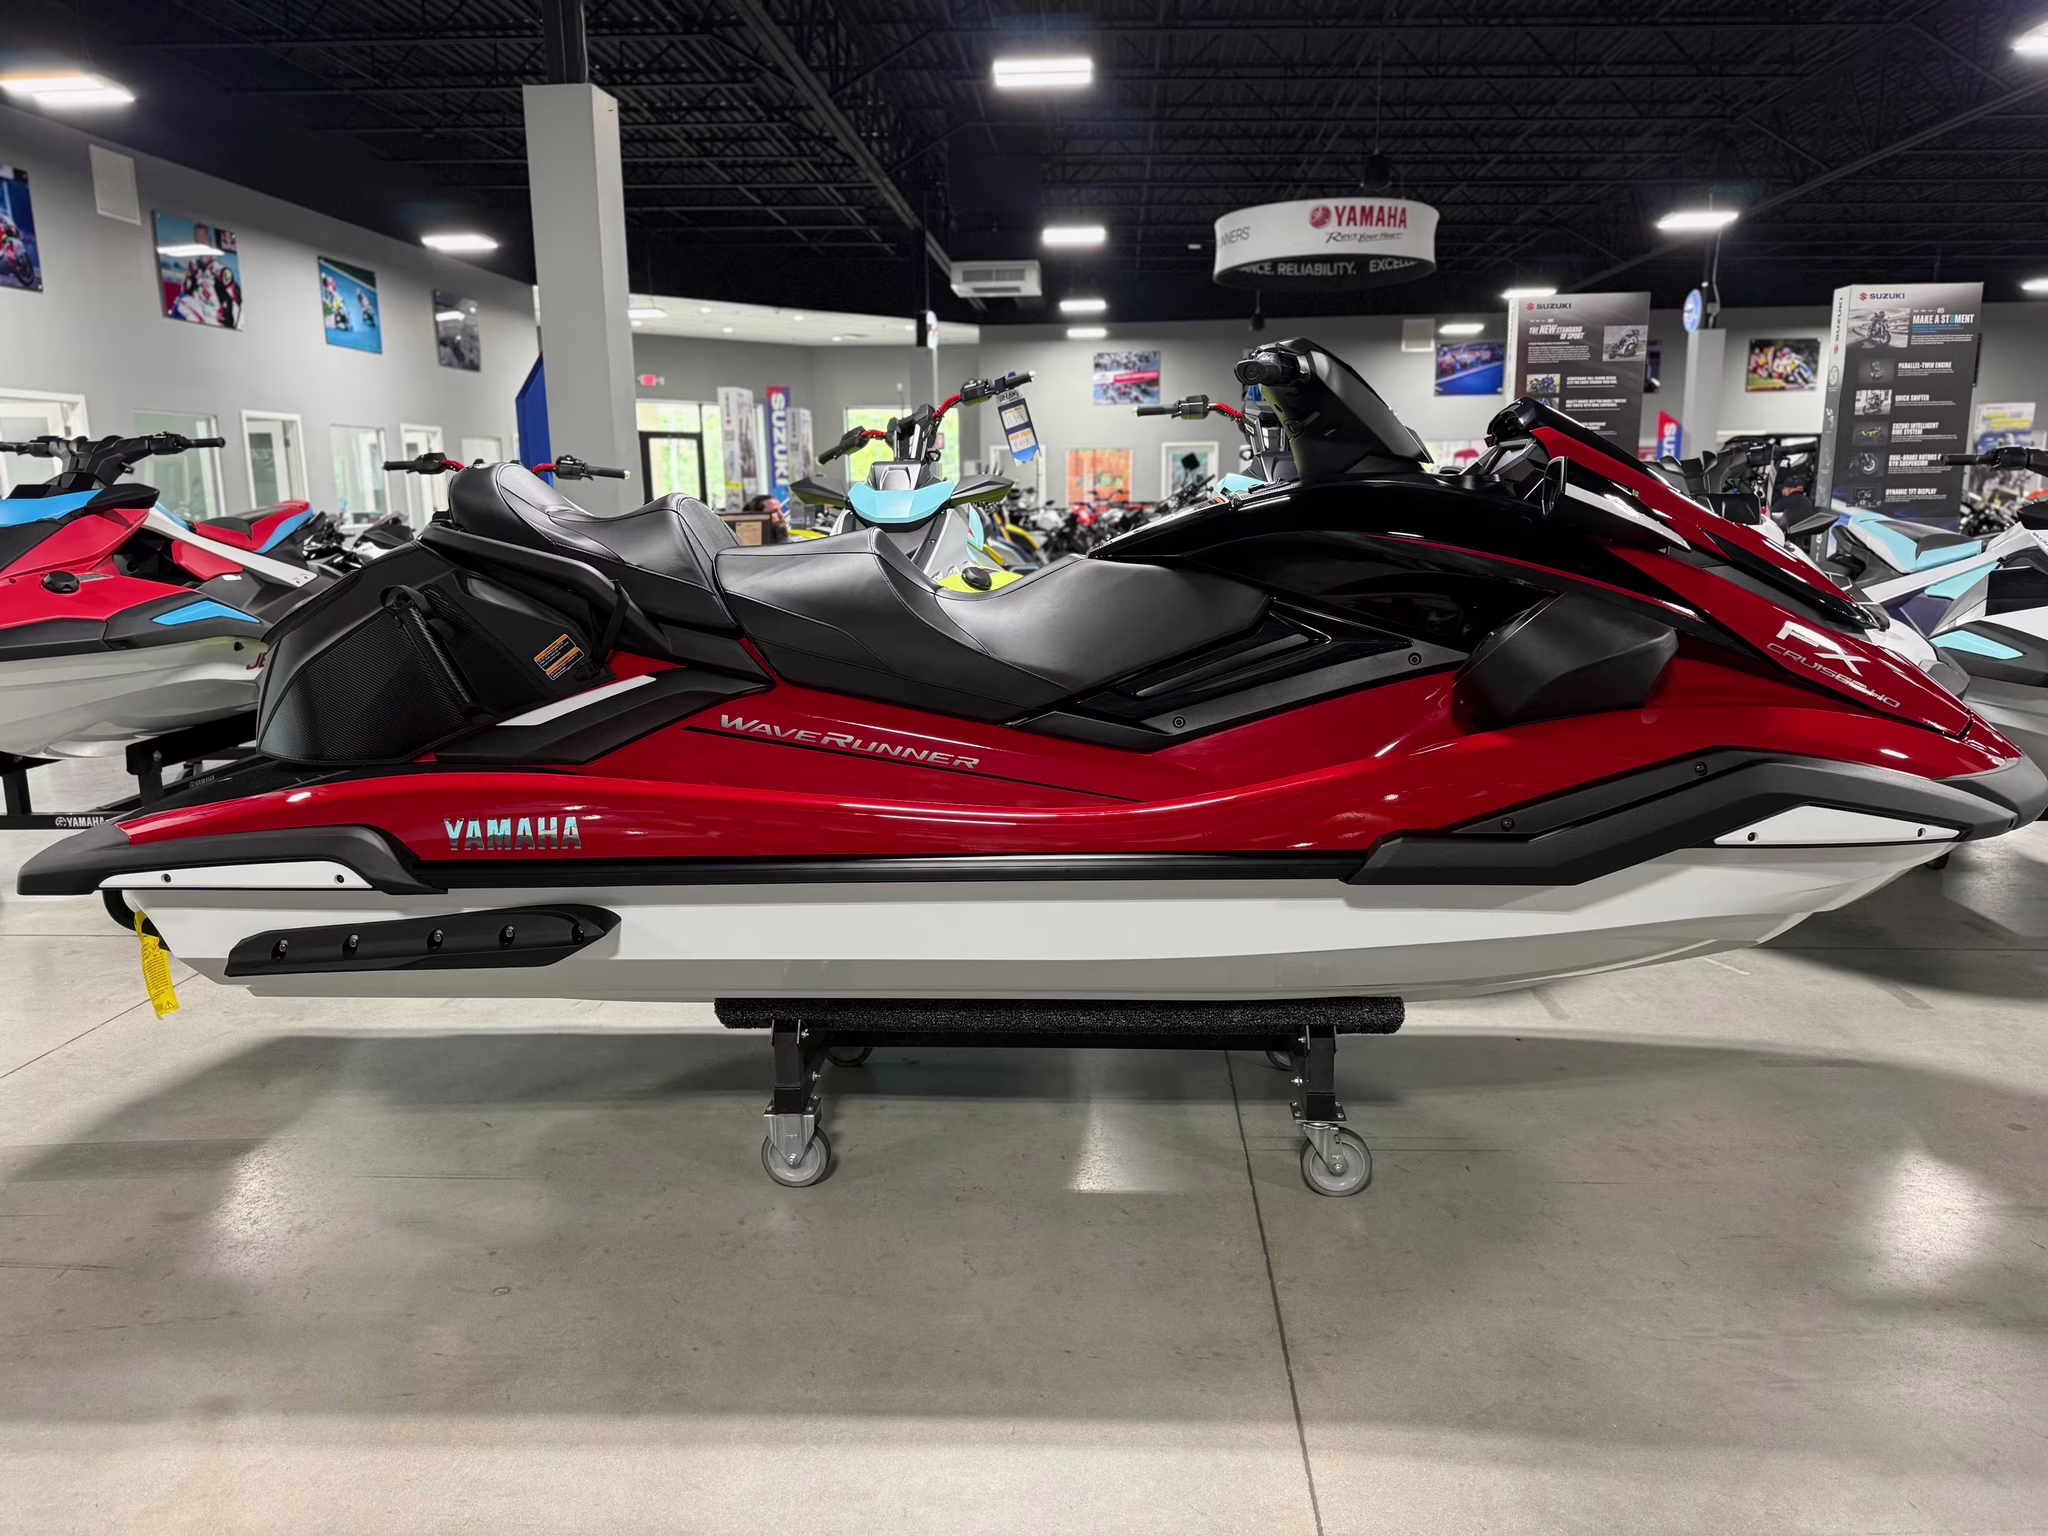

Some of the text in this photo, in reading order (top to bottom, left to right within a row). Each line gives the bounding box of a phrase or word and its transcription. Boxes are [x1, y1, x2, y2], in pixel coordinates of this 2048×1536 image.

[1334, 205, 1407, 229] YAMAHA
[1277, 261, 1357, 276] RELIABILITY.
[1870, 292, 1905, 300] SUZUKI
[1536, 302, 1572, 310] SUZUKI
[1835, 296, 1843, 342] SUZUKI
[1912, 314, 1934, 324] MAKE
[1934, 314, 1941, 324] A
[1529, 327, 1539, 335] THE
[1539, 324, 1558, 335] NEW
[1567, 332, 1585, 340] SPORT
[1898, 361, 1952, 369] PARALLEL-TWIN ENGINE
[1894, 394, 1930, 402] QUICK SHIFTER
[1910, 421, 1939, 429] INTELLIGENT
[771, 392, 789, 486] SUZUKI
[1917, 487, 1938, 495] DISPLAY
[1776, 620, 1872, 677] FX
[67, 816, 105, 828] YAMAHA
[443, 816, 582, 851] YAMAHA
